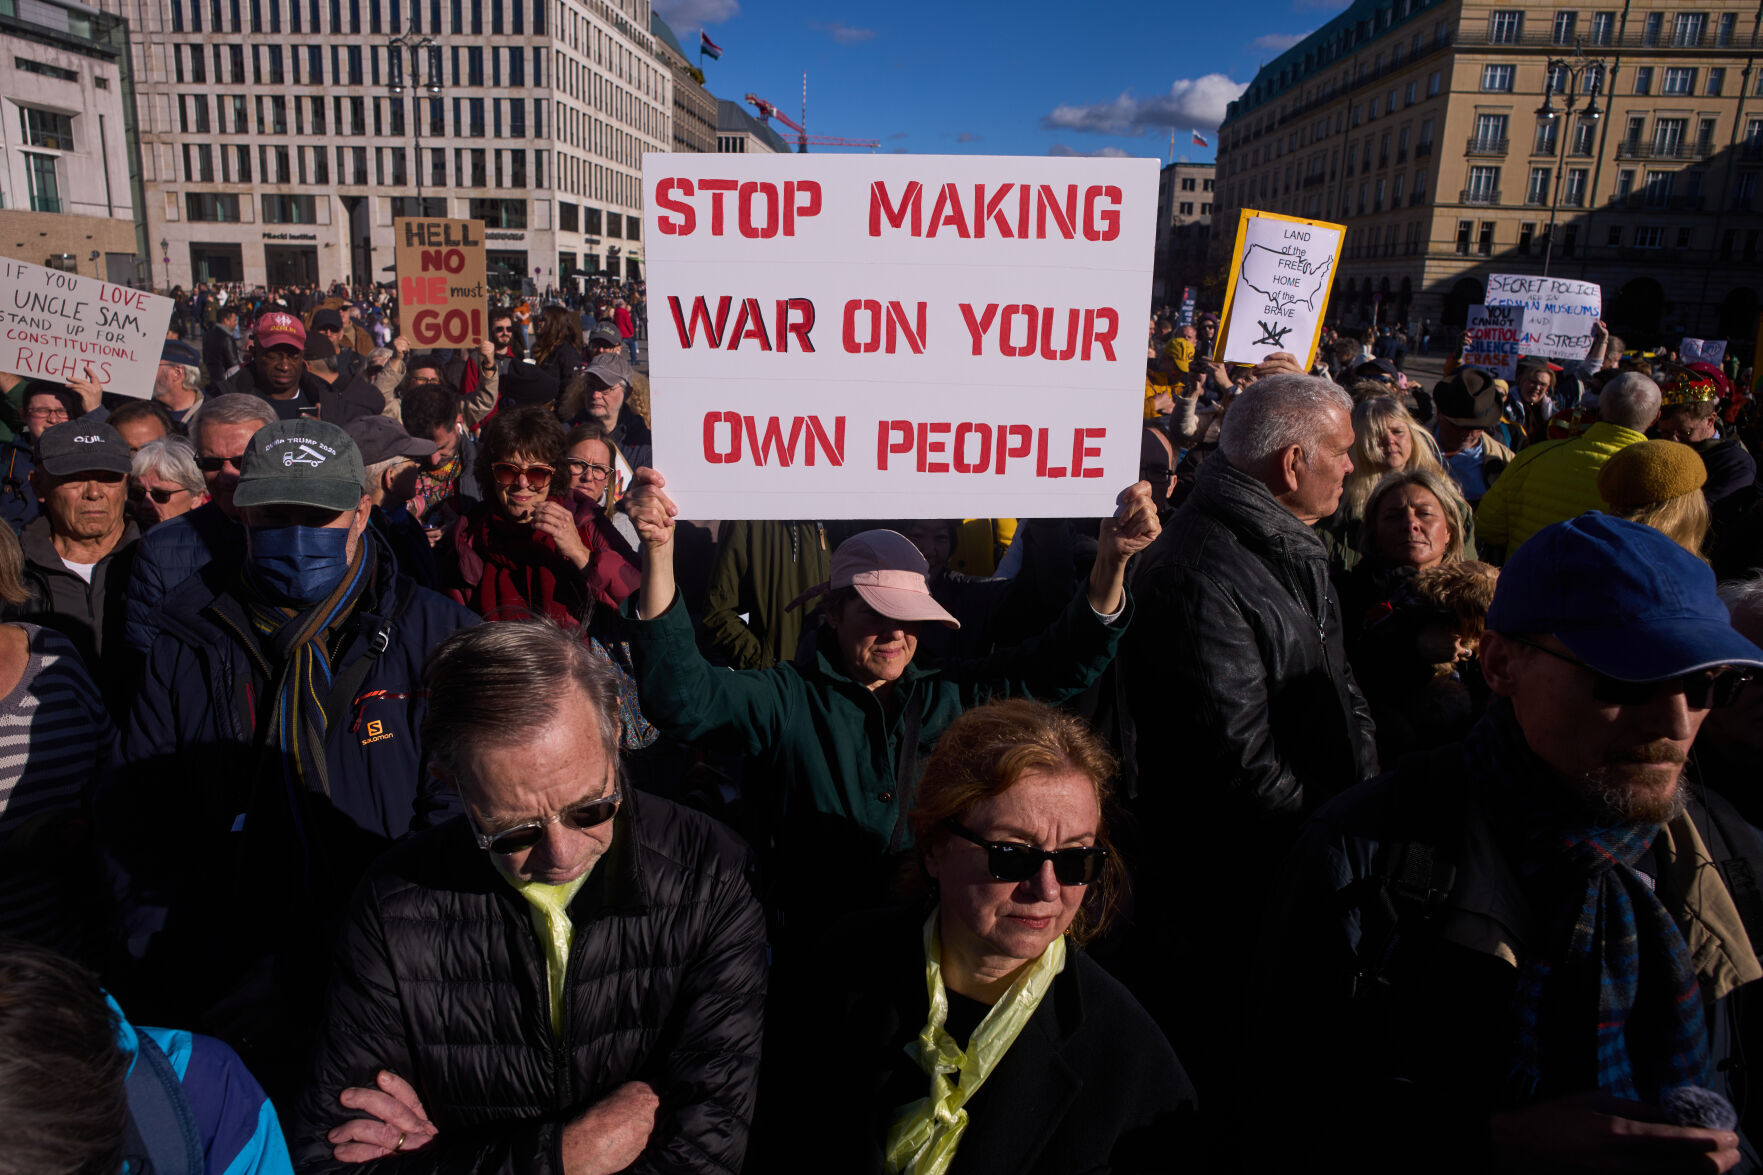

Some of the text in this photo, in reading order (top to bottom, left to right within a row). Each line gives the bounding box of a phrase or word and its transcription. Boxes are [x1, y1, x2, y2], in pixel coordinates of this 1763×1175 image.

[655, 176, 1123, 242] STOP MAKING
[405, 222, 479, 247] HELL
[1283, 229, 1311, 242] LAND
[1282, 246, 1306, 257] of the
[421, 248, 465, 274] NO
[1278, 258, 1303, 272] FREE
[7, 263, 151, 311] IF YOU LOVE
[1273, 275, 1301, 288] HOME
[1491, 275, 1600, 297] SECRET POLICE
[401, 276, 483, 306] HE must
[1272, 291, 1295, 301] of the
[15, 289, 147, 338] UNCLE SAM,
[1264, 305, 1295, 318] BRAVE
[1486, 306, 1511, 318] YOU
[1543, 304, 1600, 317] MUSEUMS
[0, 311, 126, 344] STAND UP FOR
[412, 308, 482, 345] GO!
[667, 295, 816, 353] WAR
[842, 298, 928, 354] ON
[959, 303, 1120, 362] YOUR
[1472, 317, 1514, 327] CANNOT
[1528, 317, 1550, 325] AND
[1468, 327, 1520, 343] CONTROL
[6, 329, 138, 362] CONSTITUTIONAL
[1465, 341, 1518, 354] SILENCE
[16, 347, 112, 384] RIGHTS
[1465, 353, 1509, 366] ERASE
[287, 437, 318, 445] TRUMP
[702, 410, 1107, 479] OWN PEOPLE
